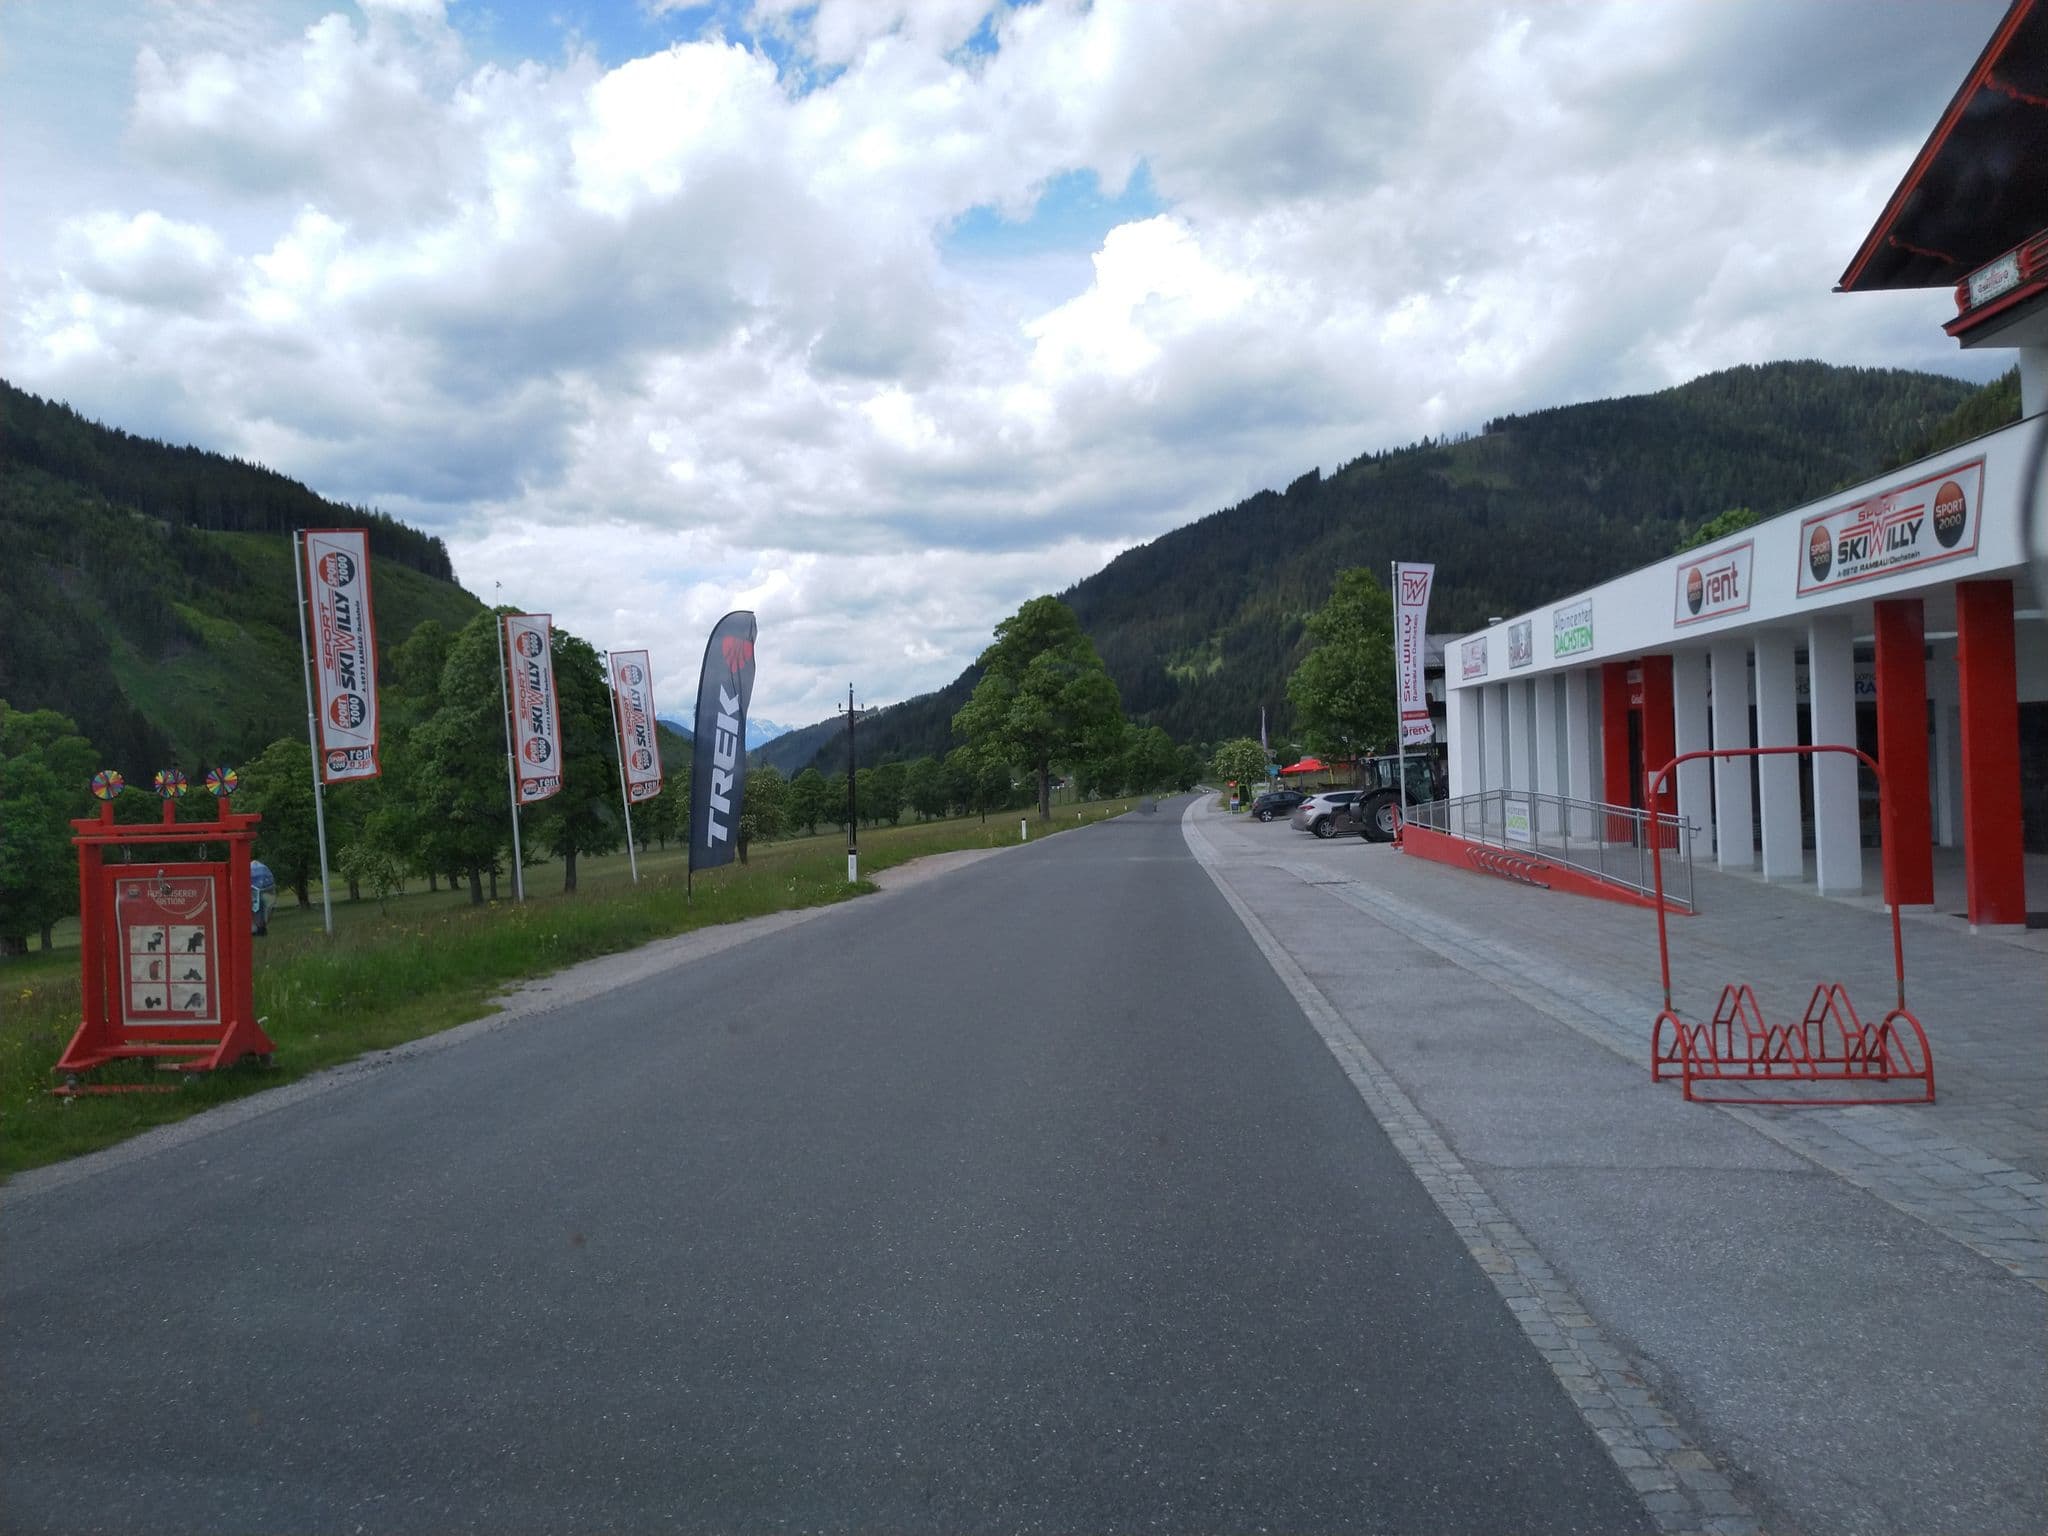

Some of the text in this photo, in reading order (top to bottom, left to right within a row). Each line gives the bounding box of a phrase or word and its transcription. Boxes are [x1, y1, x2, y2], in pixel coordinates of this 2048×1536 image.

[1858, 504, 1896, 522] SPORT
[1935, 497, 1964, 517] SPORT
[1938, 515, 1962, 530] 2000
[1810, 540, 1830, 554] SPORT
[326, 556, 338, 587] SPORT
[337, 556, 350, 582] 2000
[1706, 561, 1739, 605] rent
[320, 602, 334, 671] SPORT
[1403, 614, 1411, 702] SKI-WILLY
[520, 669, 528, 720] SPORT
[337, 698, 350, 728] SPORT
[349, 696, 361, 723] 2000
[1409, 724, 1430, 736] rent
[707, 684, 739, 848] TREK
[540, 775, 559, 787] rent
